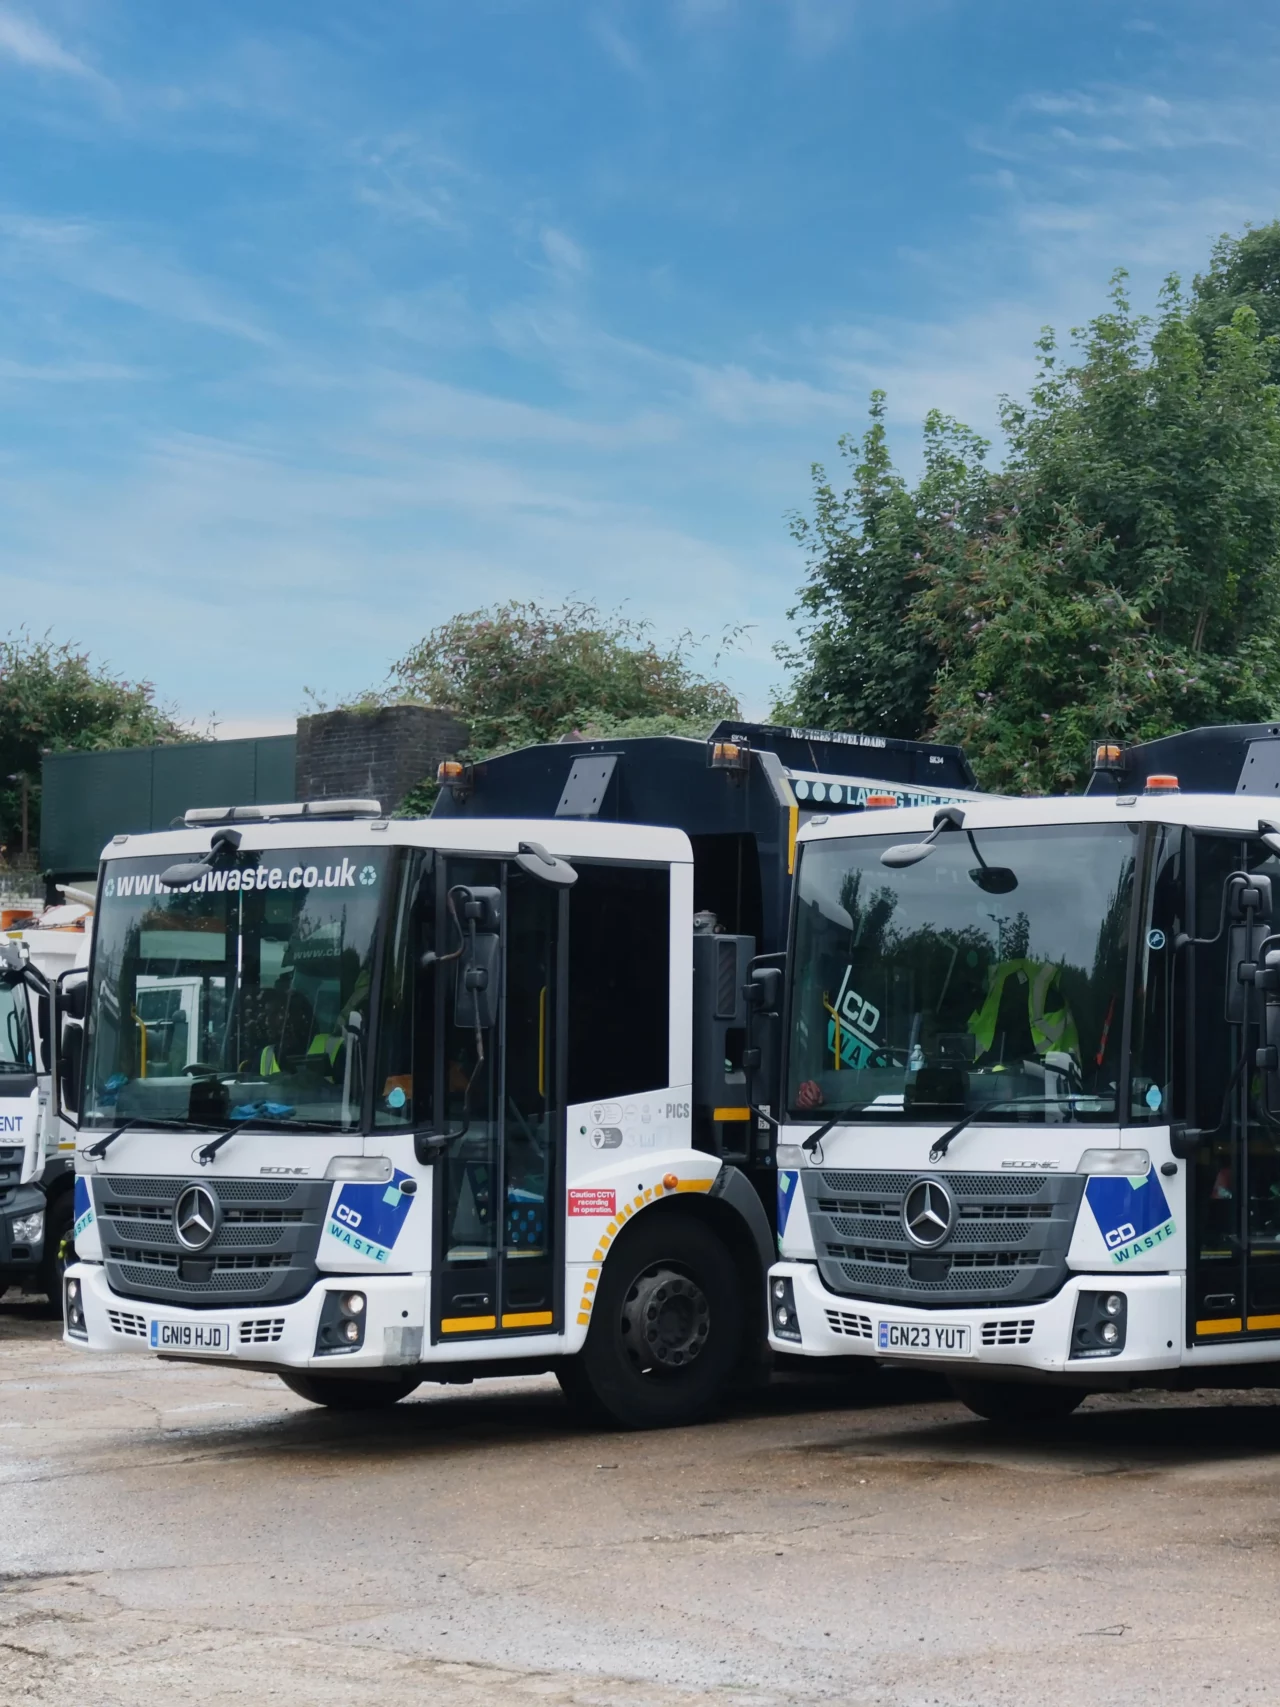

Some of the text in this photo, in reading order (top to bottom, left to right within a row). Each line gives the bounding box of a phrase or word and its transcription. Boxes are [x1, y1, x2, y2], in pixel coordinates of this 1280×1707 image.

[860, 736, 886, 748] LOADS
[843, 990, 880, 1033] CD
[666, 1103, 689, 1118] PICS
[578, 1199, 608, 1207] recording
[75, 1213, 92, 1236] STE
[336, 1204, 362, 1228] CD
[331, 1224, 385, 1261] WASTE
[1105, 1222, 1135, 1247] CD
[1114, 1224, 1172, 1262] WASTE
[162, 1325, 221, 1347] GN19 HJD
[890, 1326, 965, 1348] GN23 YUT
